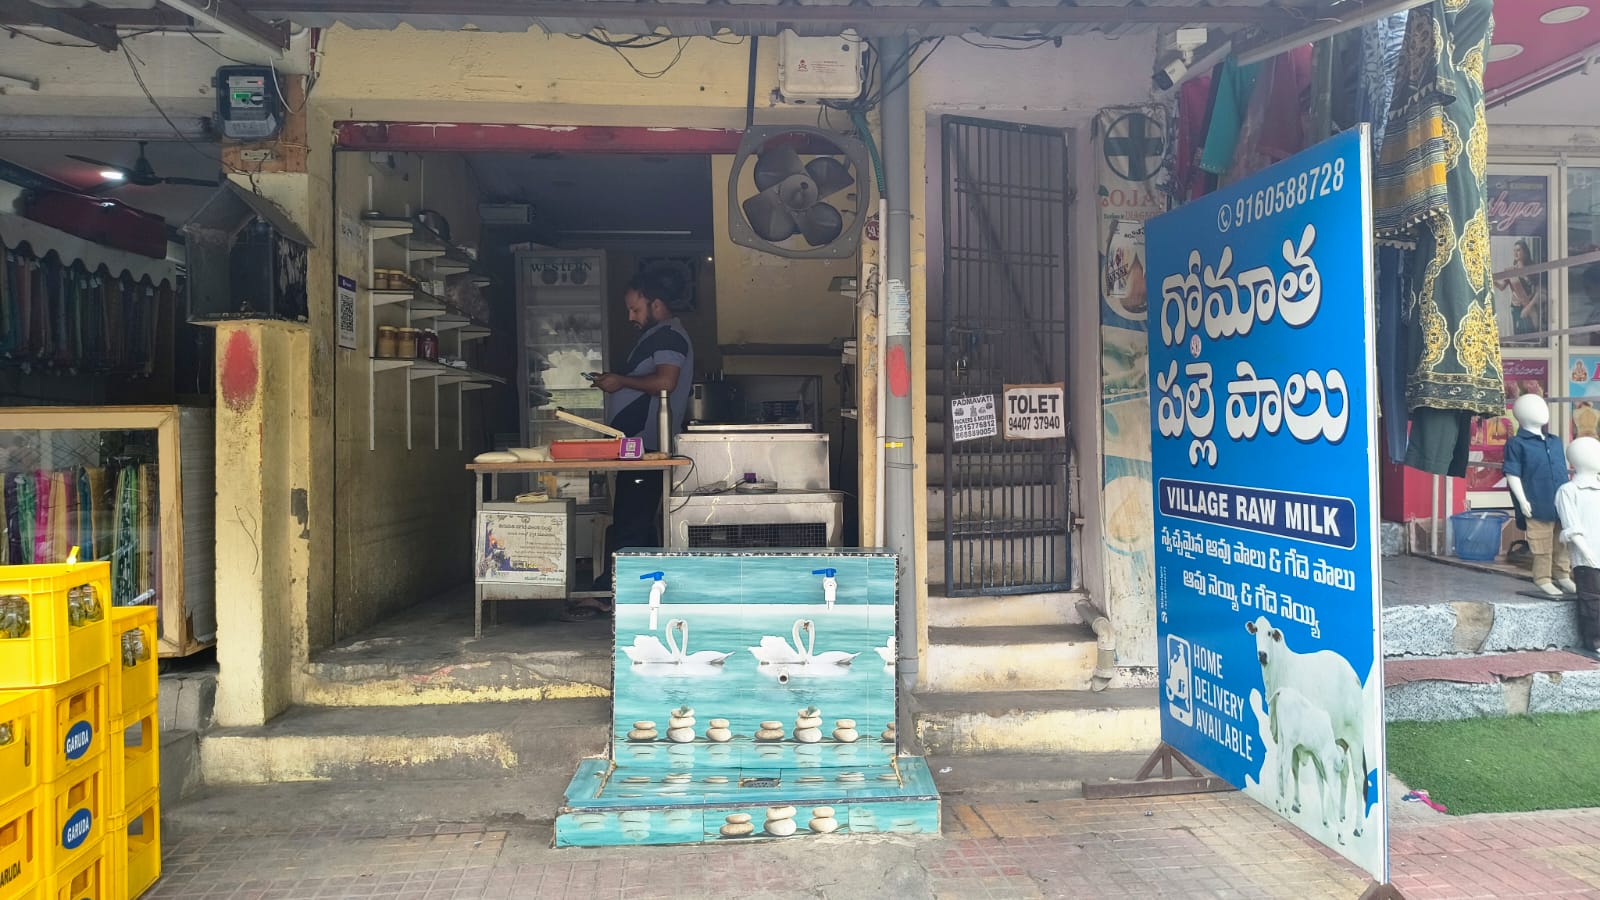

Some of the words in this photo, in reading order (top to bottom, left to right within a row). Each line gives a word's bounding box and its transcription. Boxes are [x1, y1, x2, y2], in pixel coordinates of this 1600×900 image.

[1235, 157, 1345, 227] 9160588728
[529, 262, 593, 273] WESTERN
[1161, 223, 1322, 347] గోమాత
[952, 396, 992, 407] PADMAVATI
[1008, 395, 1060, 414] TOLET
[1157, 360, 1219, 467] పల్లె
[1225, 360, 1349, 443] పాలు
[1008, 417, 1031, 431] 94407
[1034, 416, 1060, 430] 37940
[1167, 486, 1229, 518] VILLAGE
[1236, 495, 1276, 526] RAW
[1285, 501, 1341, 537] MILK
[1206, 538, 1231, 565] ఆవు
[1233, 541, 1266, 569] పాలు
[1269, 547, 1282, 573] &
[1284, 548, 1309, 580] గేదె
[1313, 558, 1355, 591] పాలు
[1183, 570, 1206, 596] ఆవు
[1208, 573, 1239, 612] నెయ్యి
[1241, 582, 1252, 607] &
[1255, 583, 1277, 614] గేదె
[1280, 593, 1320, 639] నెయ్యి
[1193, 643, 1223, 679] HOME
[1194, 679, 1245, 721] DELIVERY
[66, 730, 89, 753] GARUDA
[1196, 707, 1253, 762] AVAILABLE
[67, 817, 90, 843] GARUDA
[0, 860, 21, 888] ARUDA
